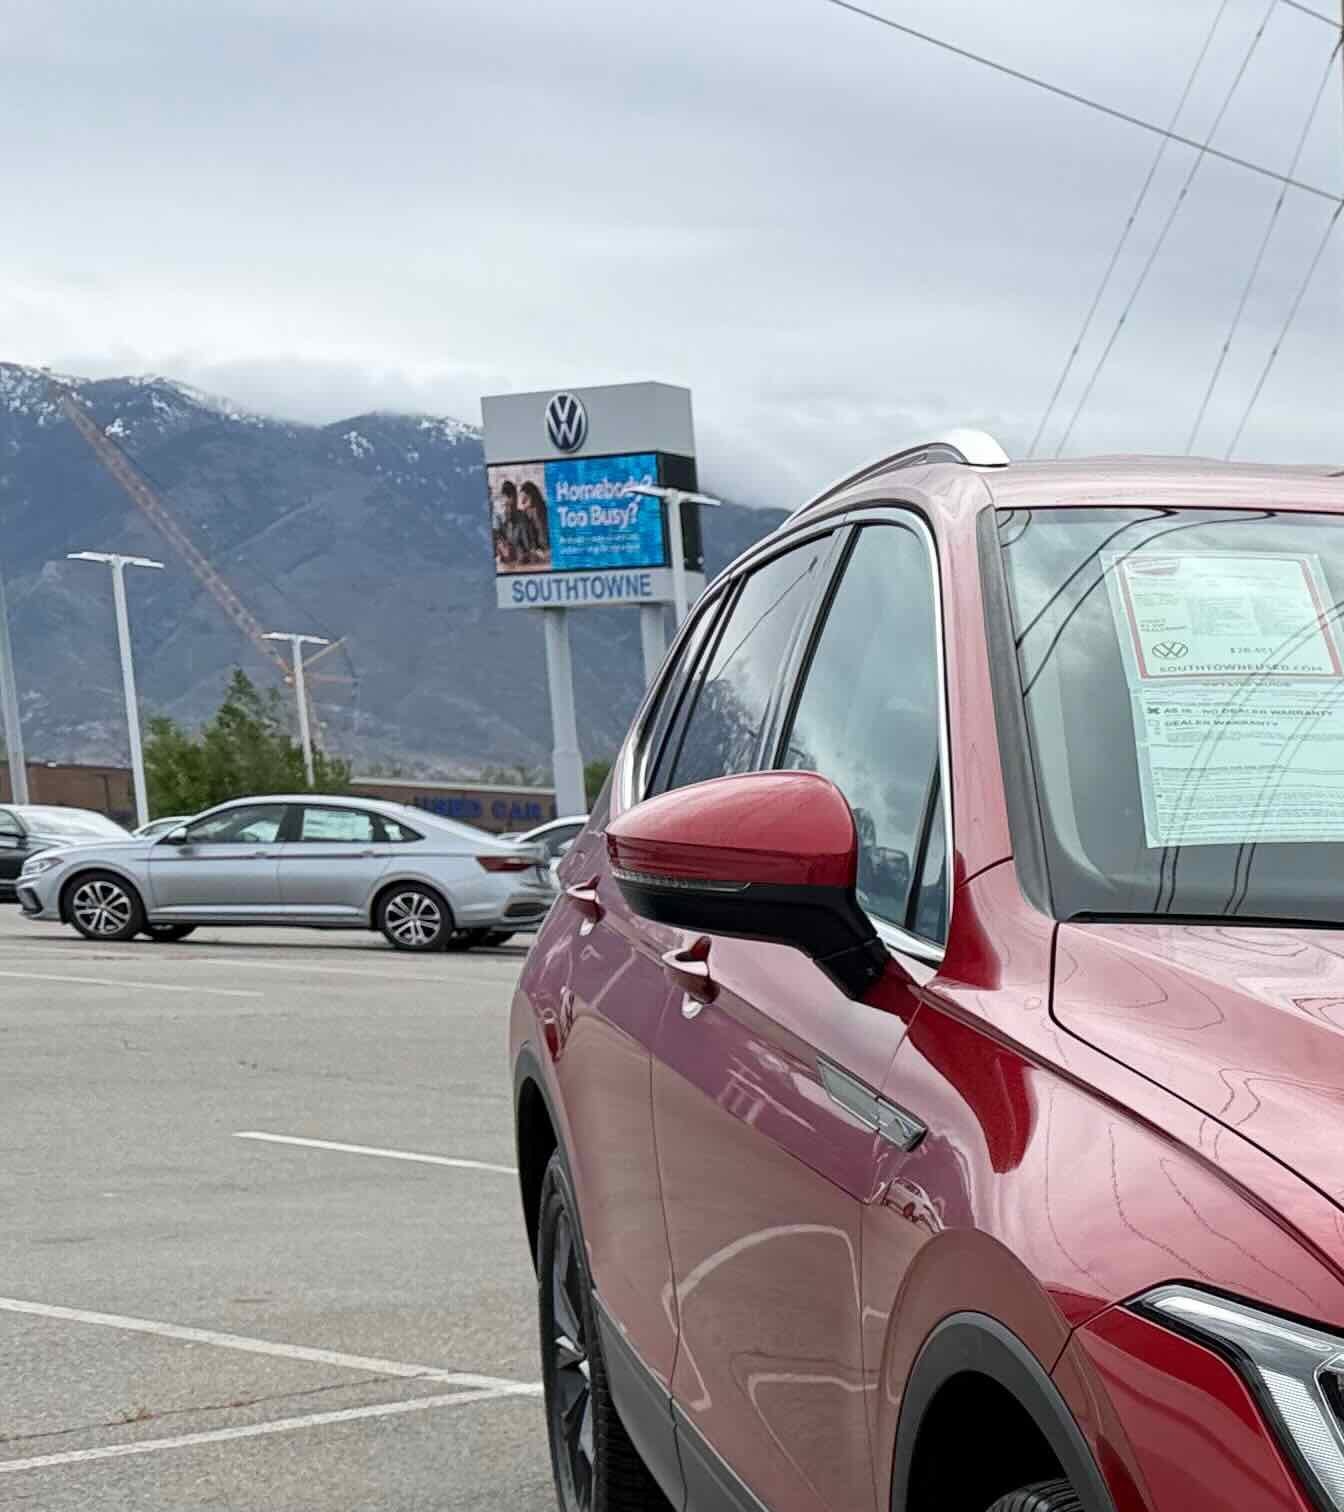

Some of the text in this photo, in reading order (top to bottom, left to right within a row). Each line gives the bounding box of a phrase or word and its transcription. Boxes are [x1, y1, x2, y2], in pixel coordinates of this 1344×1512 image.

[557, 503, 639, 529] Too Busy?
[511, 574, 653, 602] SOUTHTOWNE
